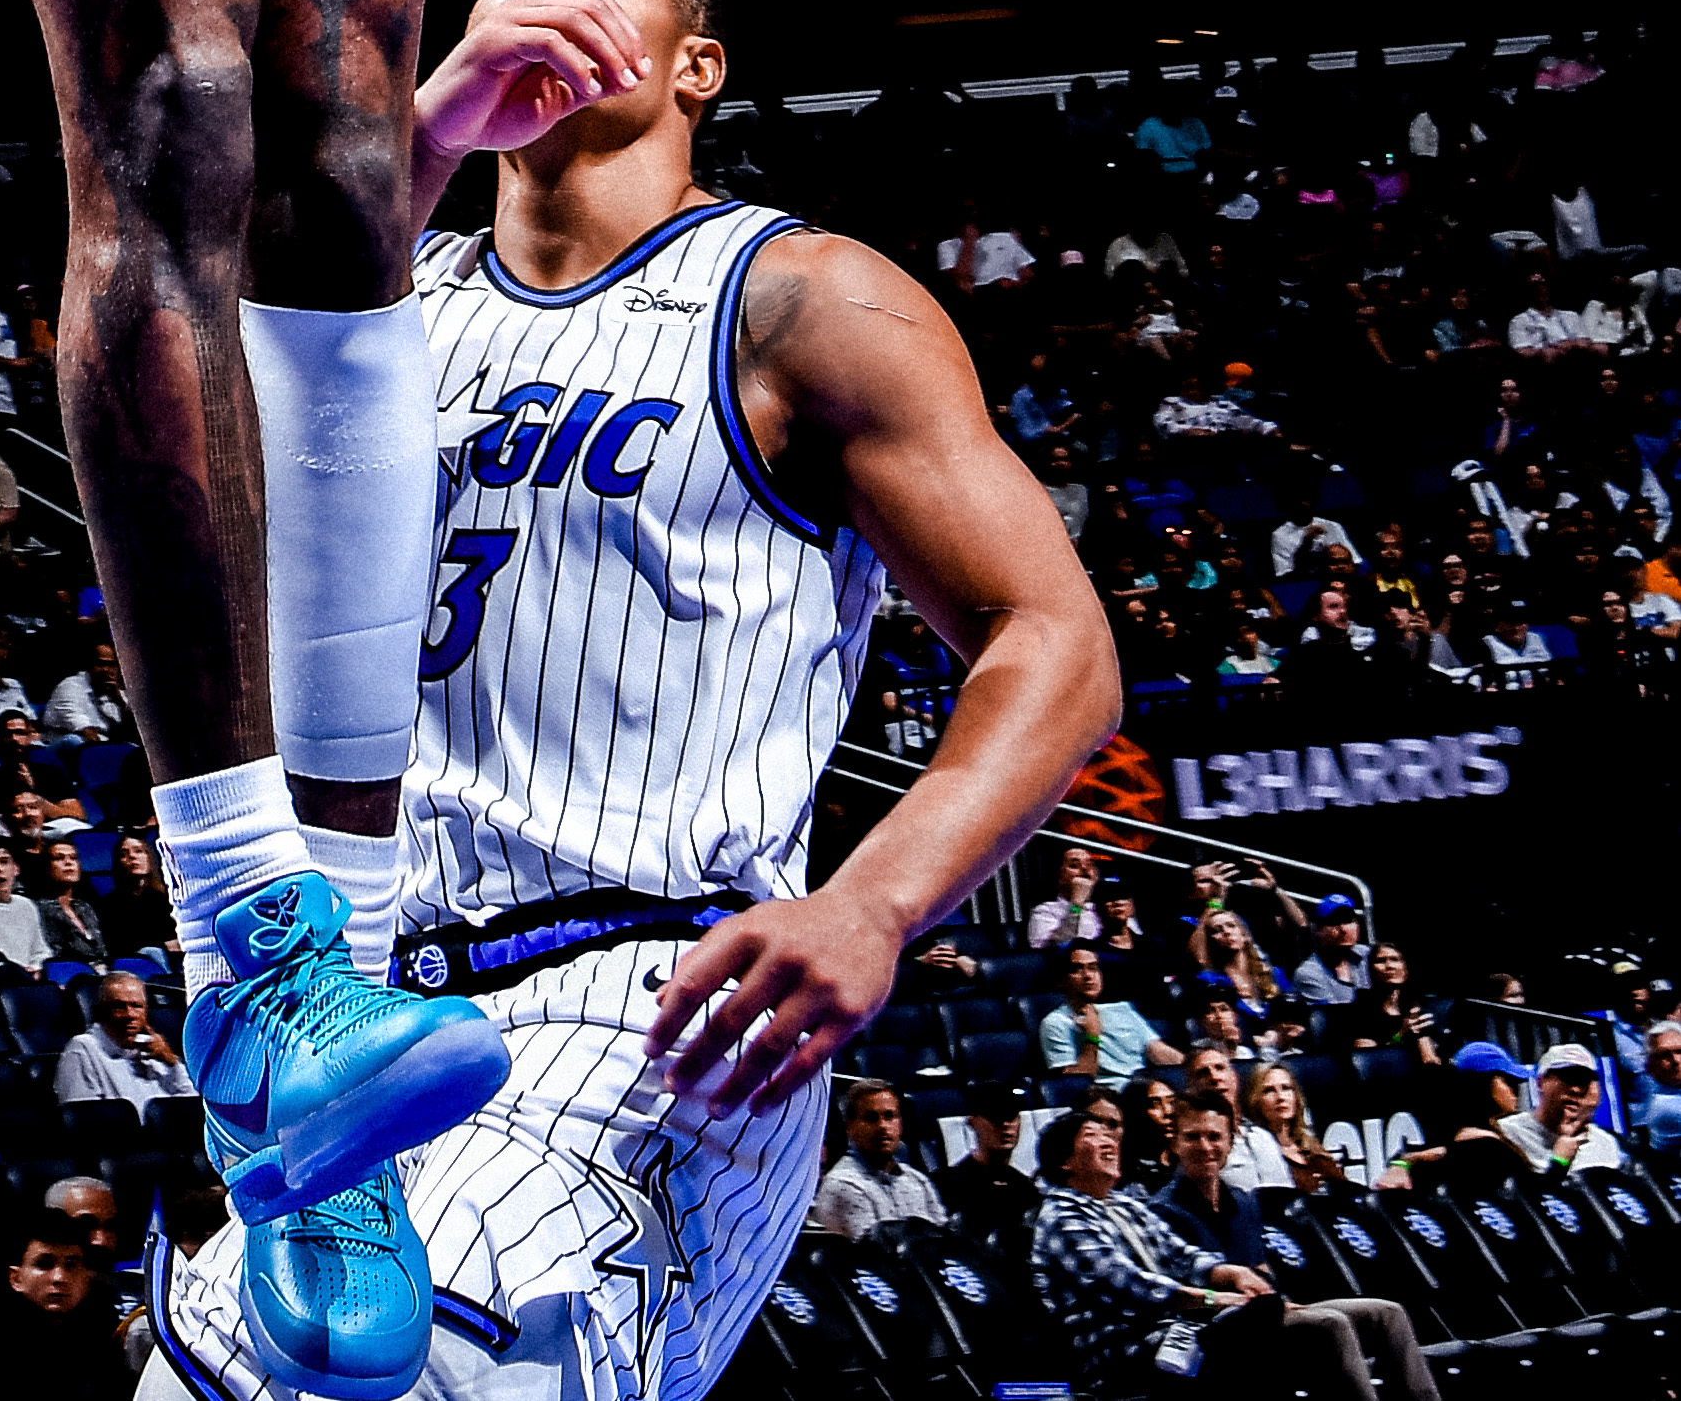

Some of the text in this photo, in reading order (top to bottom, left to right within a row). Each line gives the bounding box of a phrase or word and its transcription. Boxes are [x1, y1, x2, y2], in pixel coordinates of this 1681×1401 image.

[623, 287, 707, 318] Disney
[419, 528, 519, 681] 3
[1174, 730, 1512, 820] L3HARRIS
